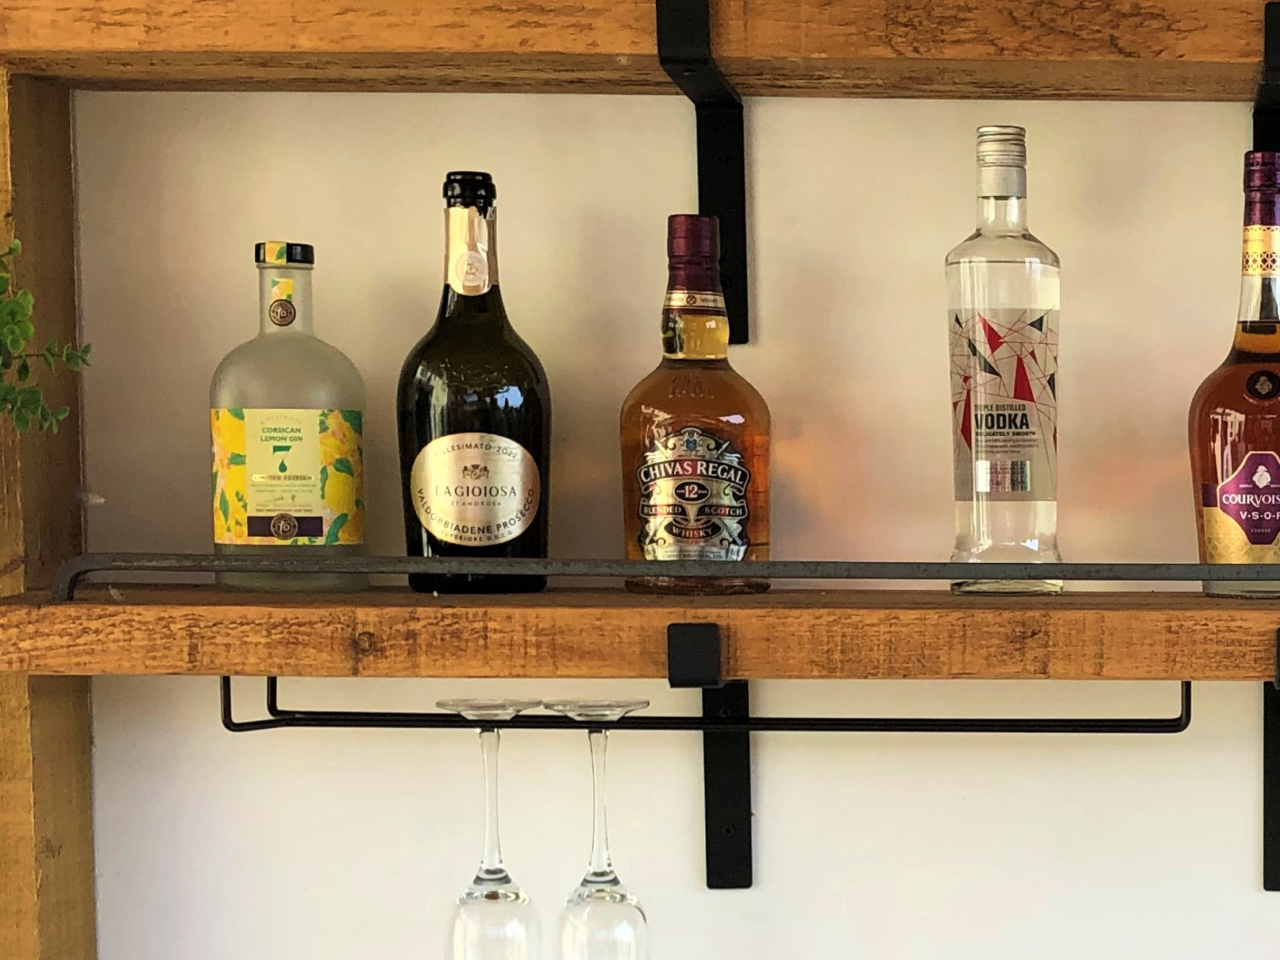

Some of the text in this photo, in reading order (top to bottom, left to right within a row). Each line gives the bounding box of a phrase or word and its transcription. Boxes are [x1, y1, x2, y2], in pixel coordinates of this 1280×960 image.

[995, 403, 1027, 412] DISTILLED
[974, 413, 1030, 430] VODKA
[640, 460, 744, 484] CHIVAS REGAL
[496, 488, 535, 532] PROSECCO
[643, 506, 743, 516] BLENDED SCOTCH
[671, 526, 713, 539] WHISKY
